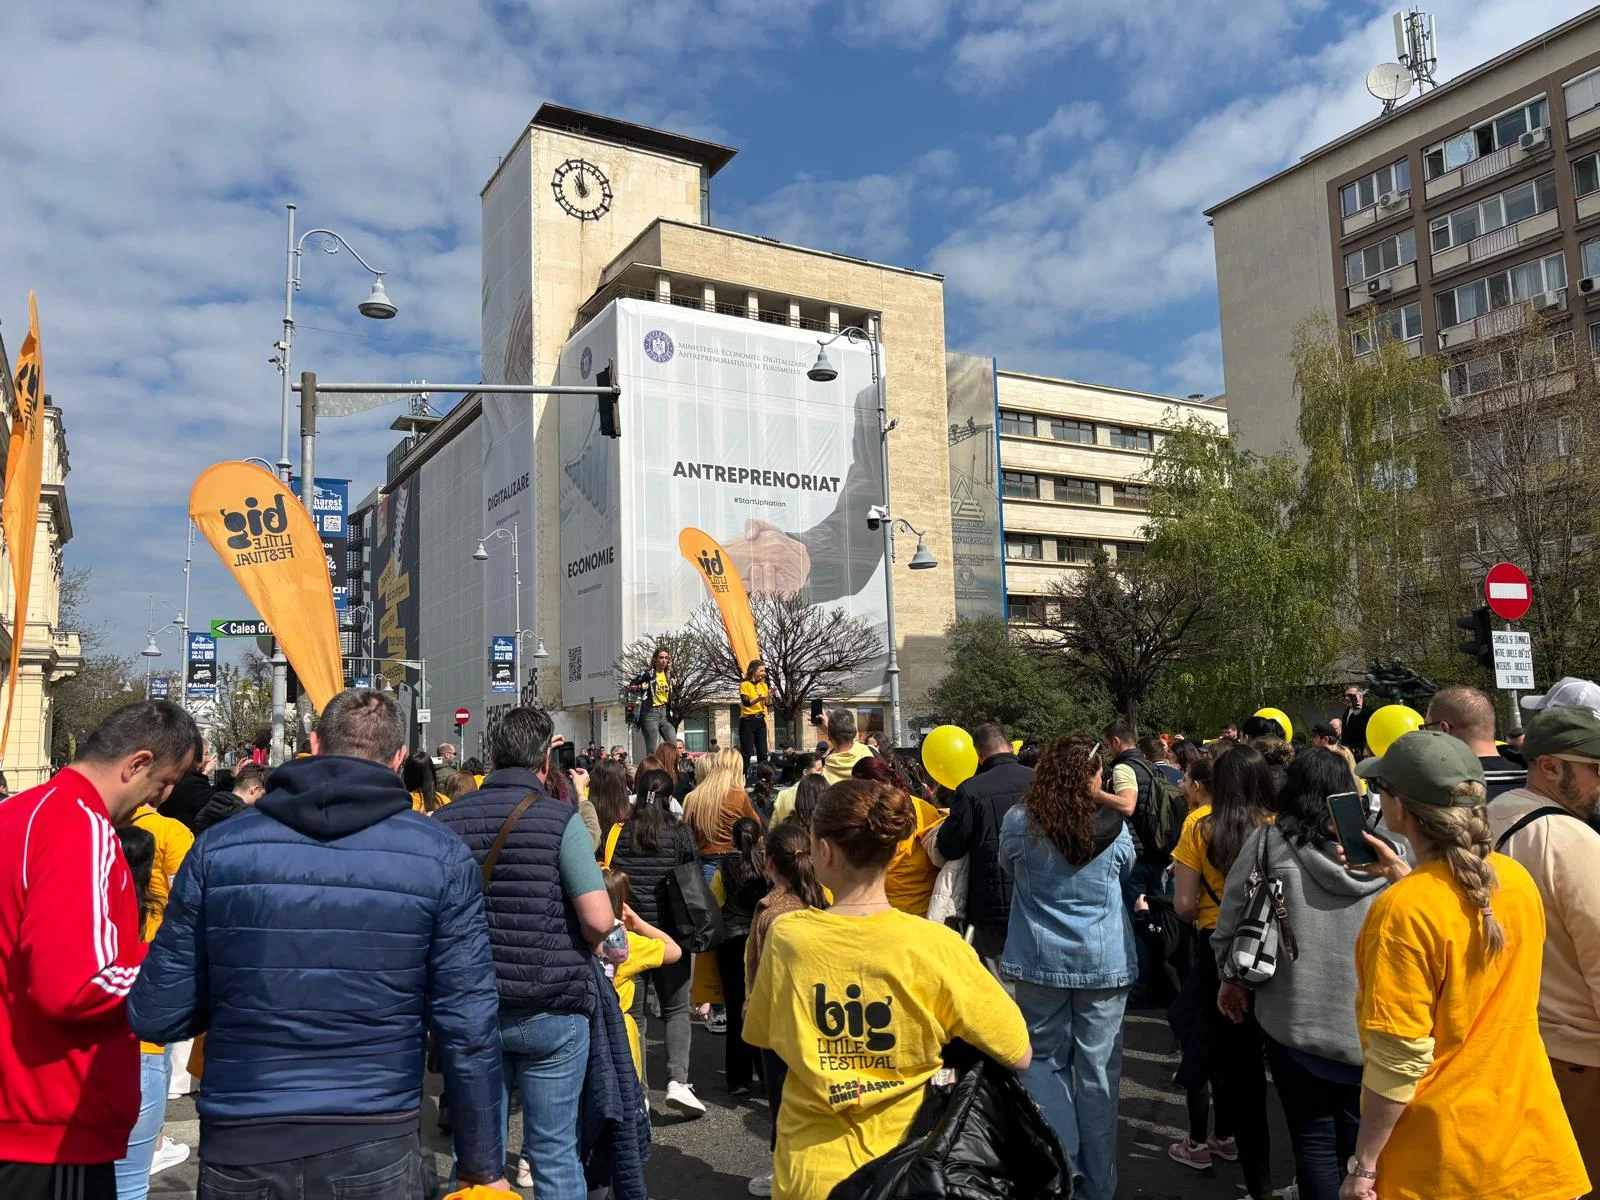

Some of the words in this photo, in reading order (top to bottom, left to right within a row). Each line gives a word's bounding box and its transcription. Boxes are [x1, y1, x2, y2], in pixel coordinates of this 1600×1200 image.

[672, 461, 841, 493] ANTREPRENORIAT
[487, 471, 530, 512] DIGITALIZARE
[734, 497, 787, 509] #StartUpNation
[567, 545, 614, 579] ECONOMIE
[230, 622, 256, 634] Calea
[812, 983, 896, 1052] big
[817, 1036, 865, 1055] LITTLE
[819, 1055, 897, 1071] FESTIVAL
[829, 1080, 859, 1095] 21-23
[828, 1089, 859, 1105] IUNIE
